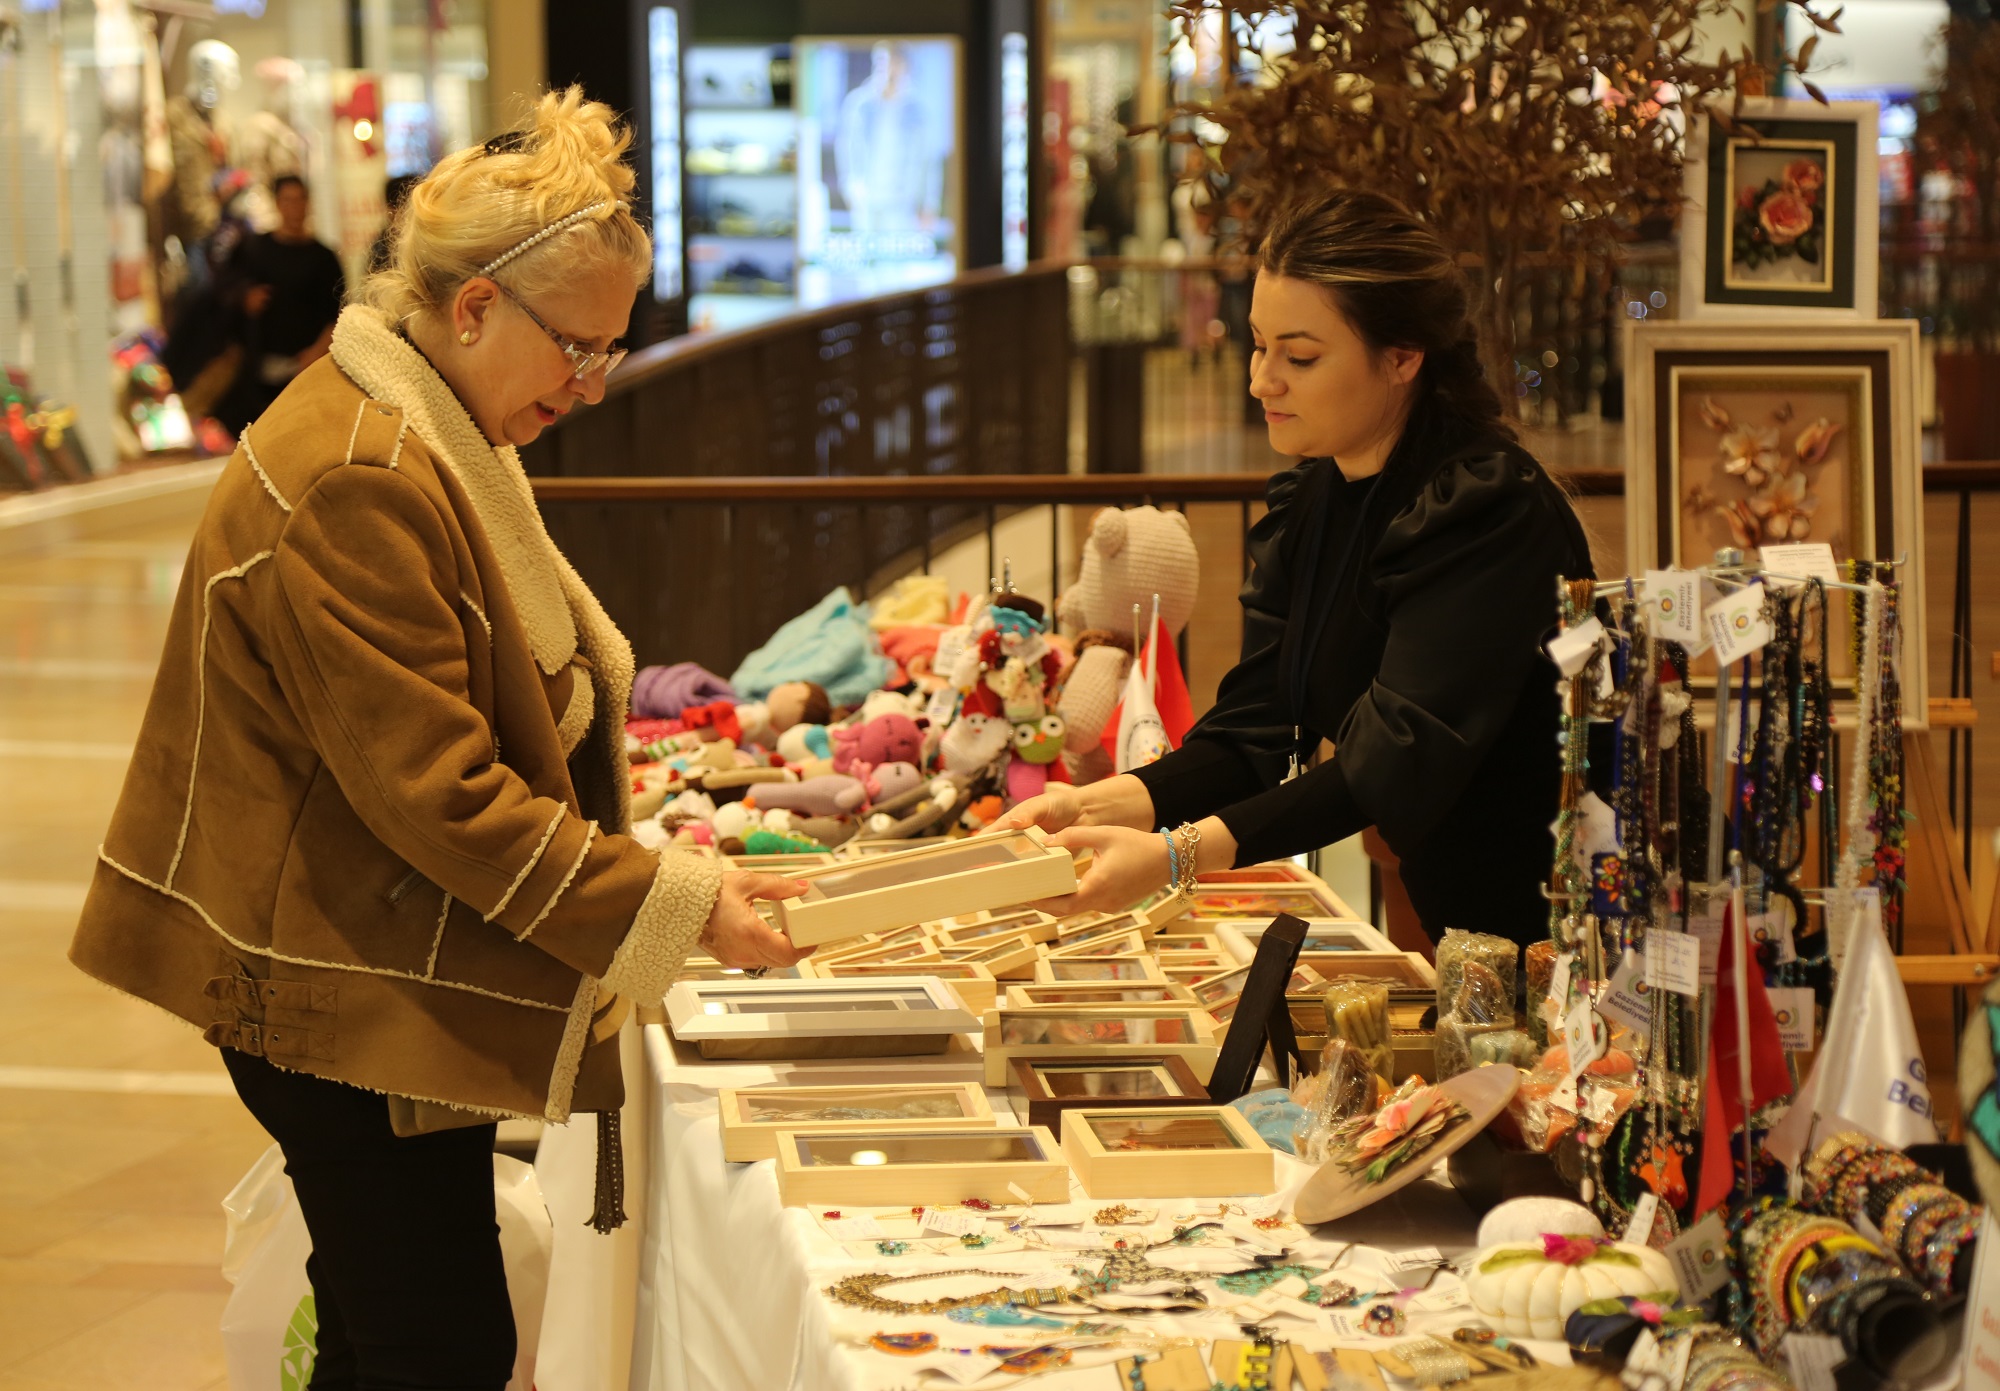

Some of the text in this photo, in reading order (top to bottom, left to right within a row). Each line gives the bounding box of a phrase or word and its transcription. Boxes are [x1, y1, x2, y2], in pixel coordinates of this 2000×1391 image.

[1608, 997, 1651, 1024] Belediyesi
[1615, 991, 1652, 1015] Gaziemir
[1780, 1031, 1805, 1040] iemir
